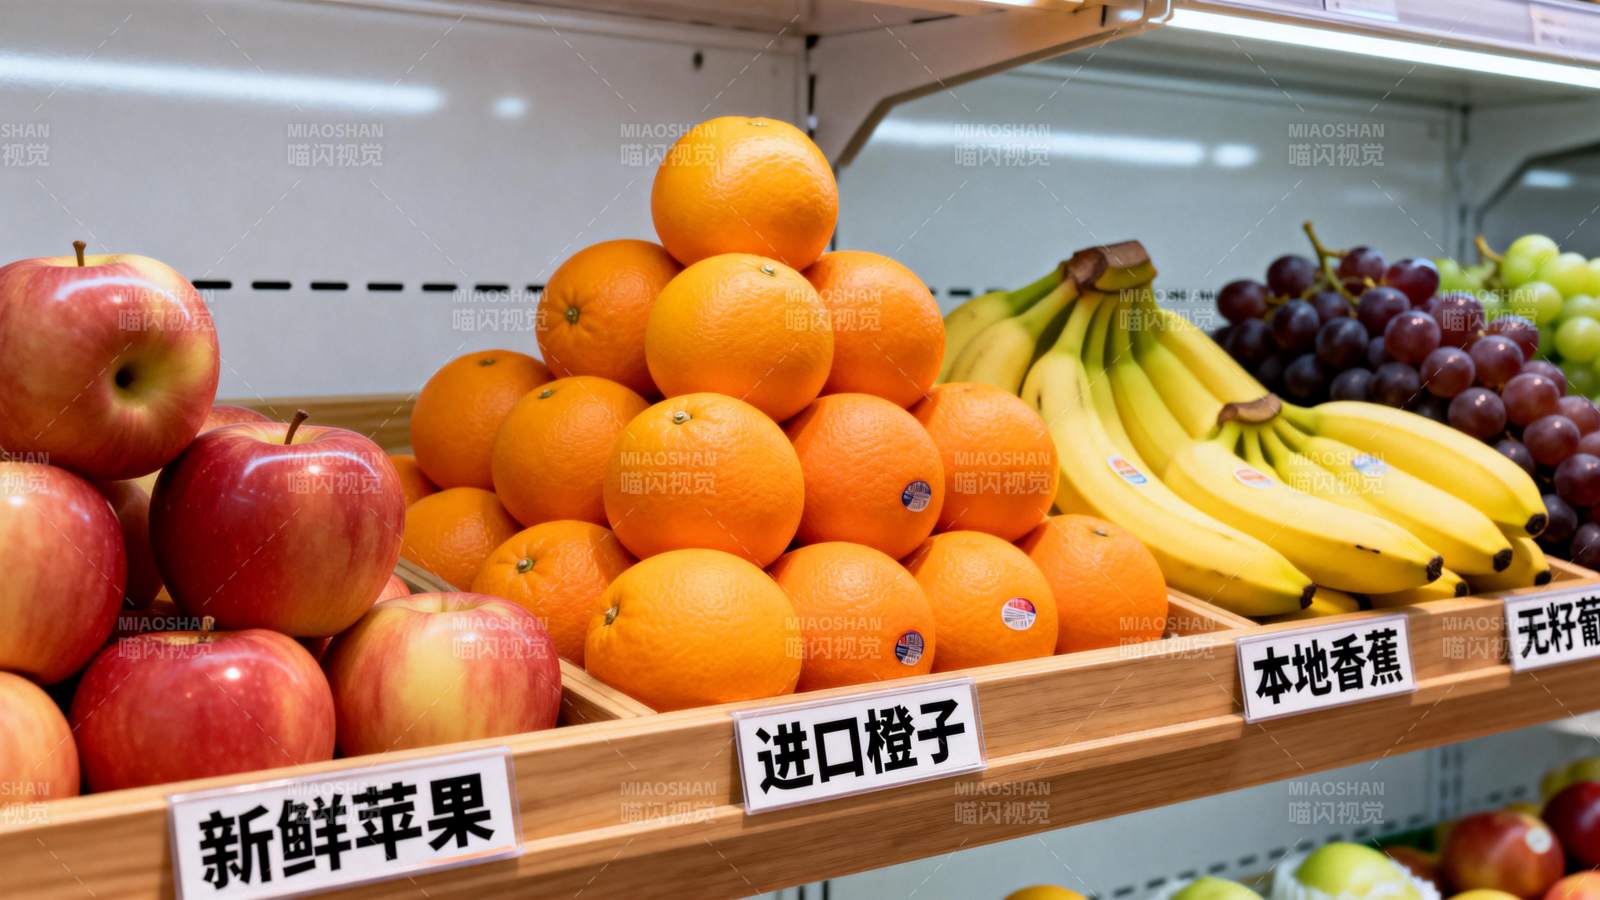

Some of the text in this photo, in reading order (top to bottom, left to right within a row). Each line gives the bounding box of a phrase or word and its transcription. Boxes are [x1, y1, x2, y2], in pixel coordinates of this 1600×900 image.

[1254, 628, 1403, 704] 本地香蕉
[1518, 596, 1600, 658] 无籽葡
[757, 699, 965, 794] 进口橙子
[199, 773, 495, 890] 新鲜苹果
